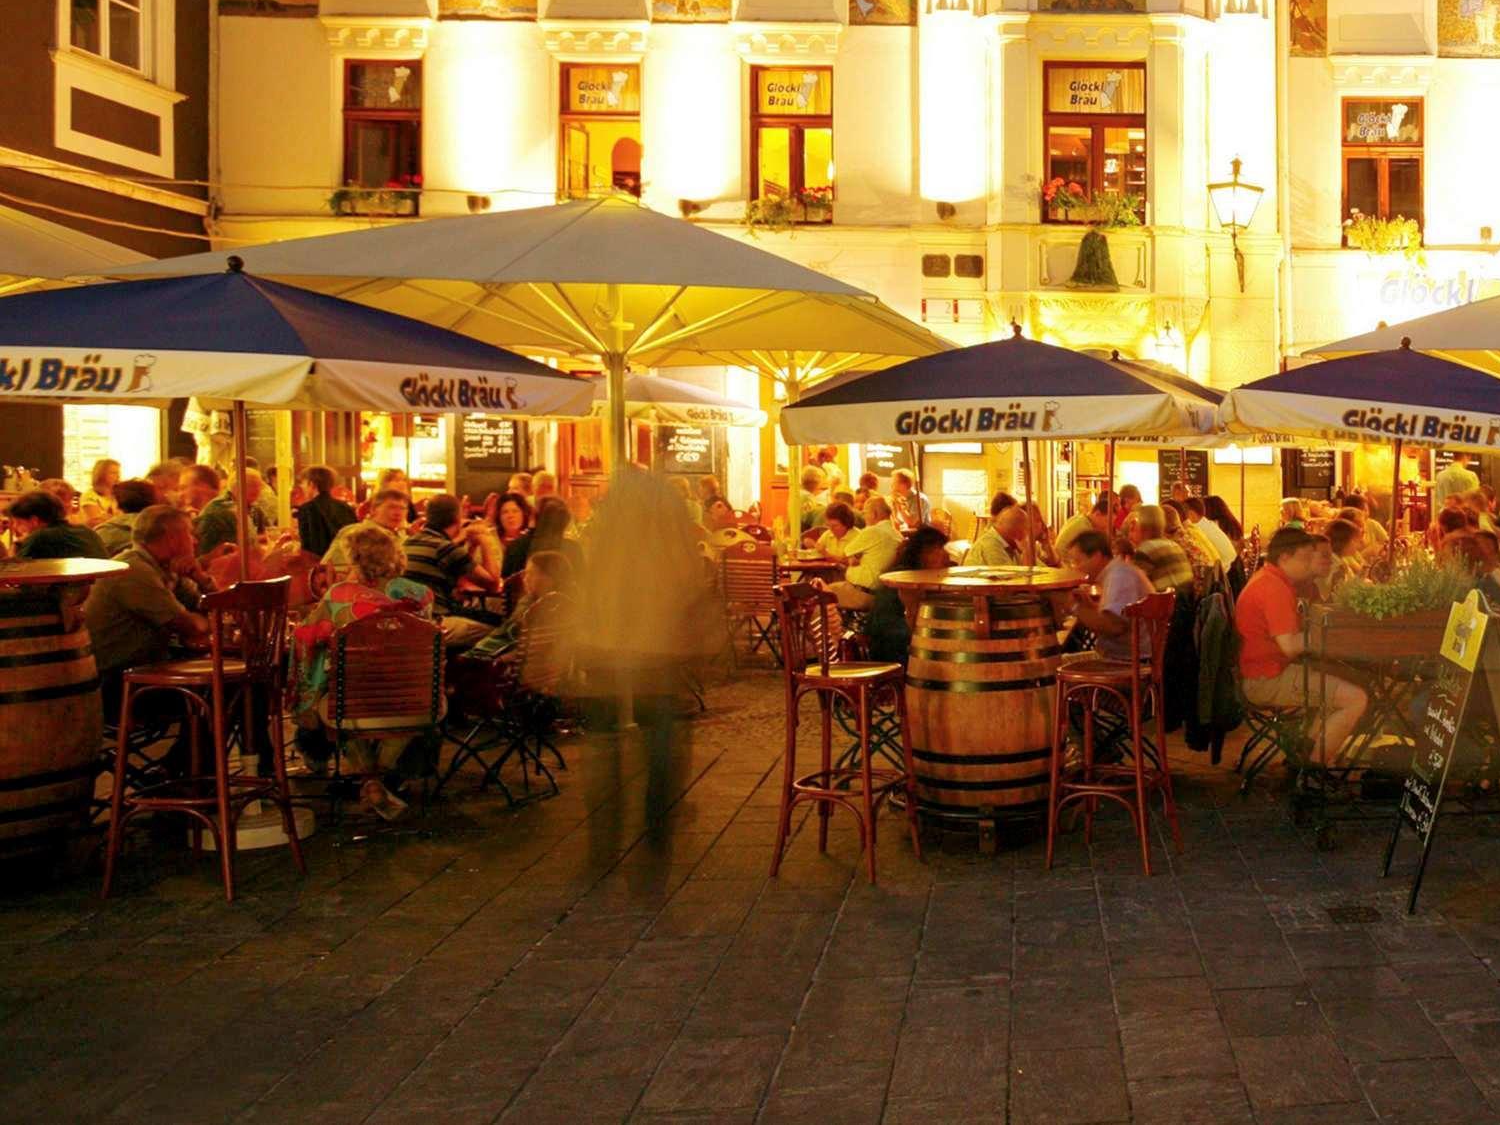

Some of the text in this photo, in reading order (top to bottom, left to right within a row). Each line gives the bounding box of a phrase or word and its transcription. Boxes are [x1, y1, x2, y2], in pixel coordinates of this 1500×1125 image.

[32, 353, 122, 393] Bräu
[400, 373, 506, 409] Glöckl Bräu
[895, 402, 1037, 436] Glöckl Bräu
[1342, 407, 1419, 437] Glöckl
[1421, 414, 1482, 444] Bräu
